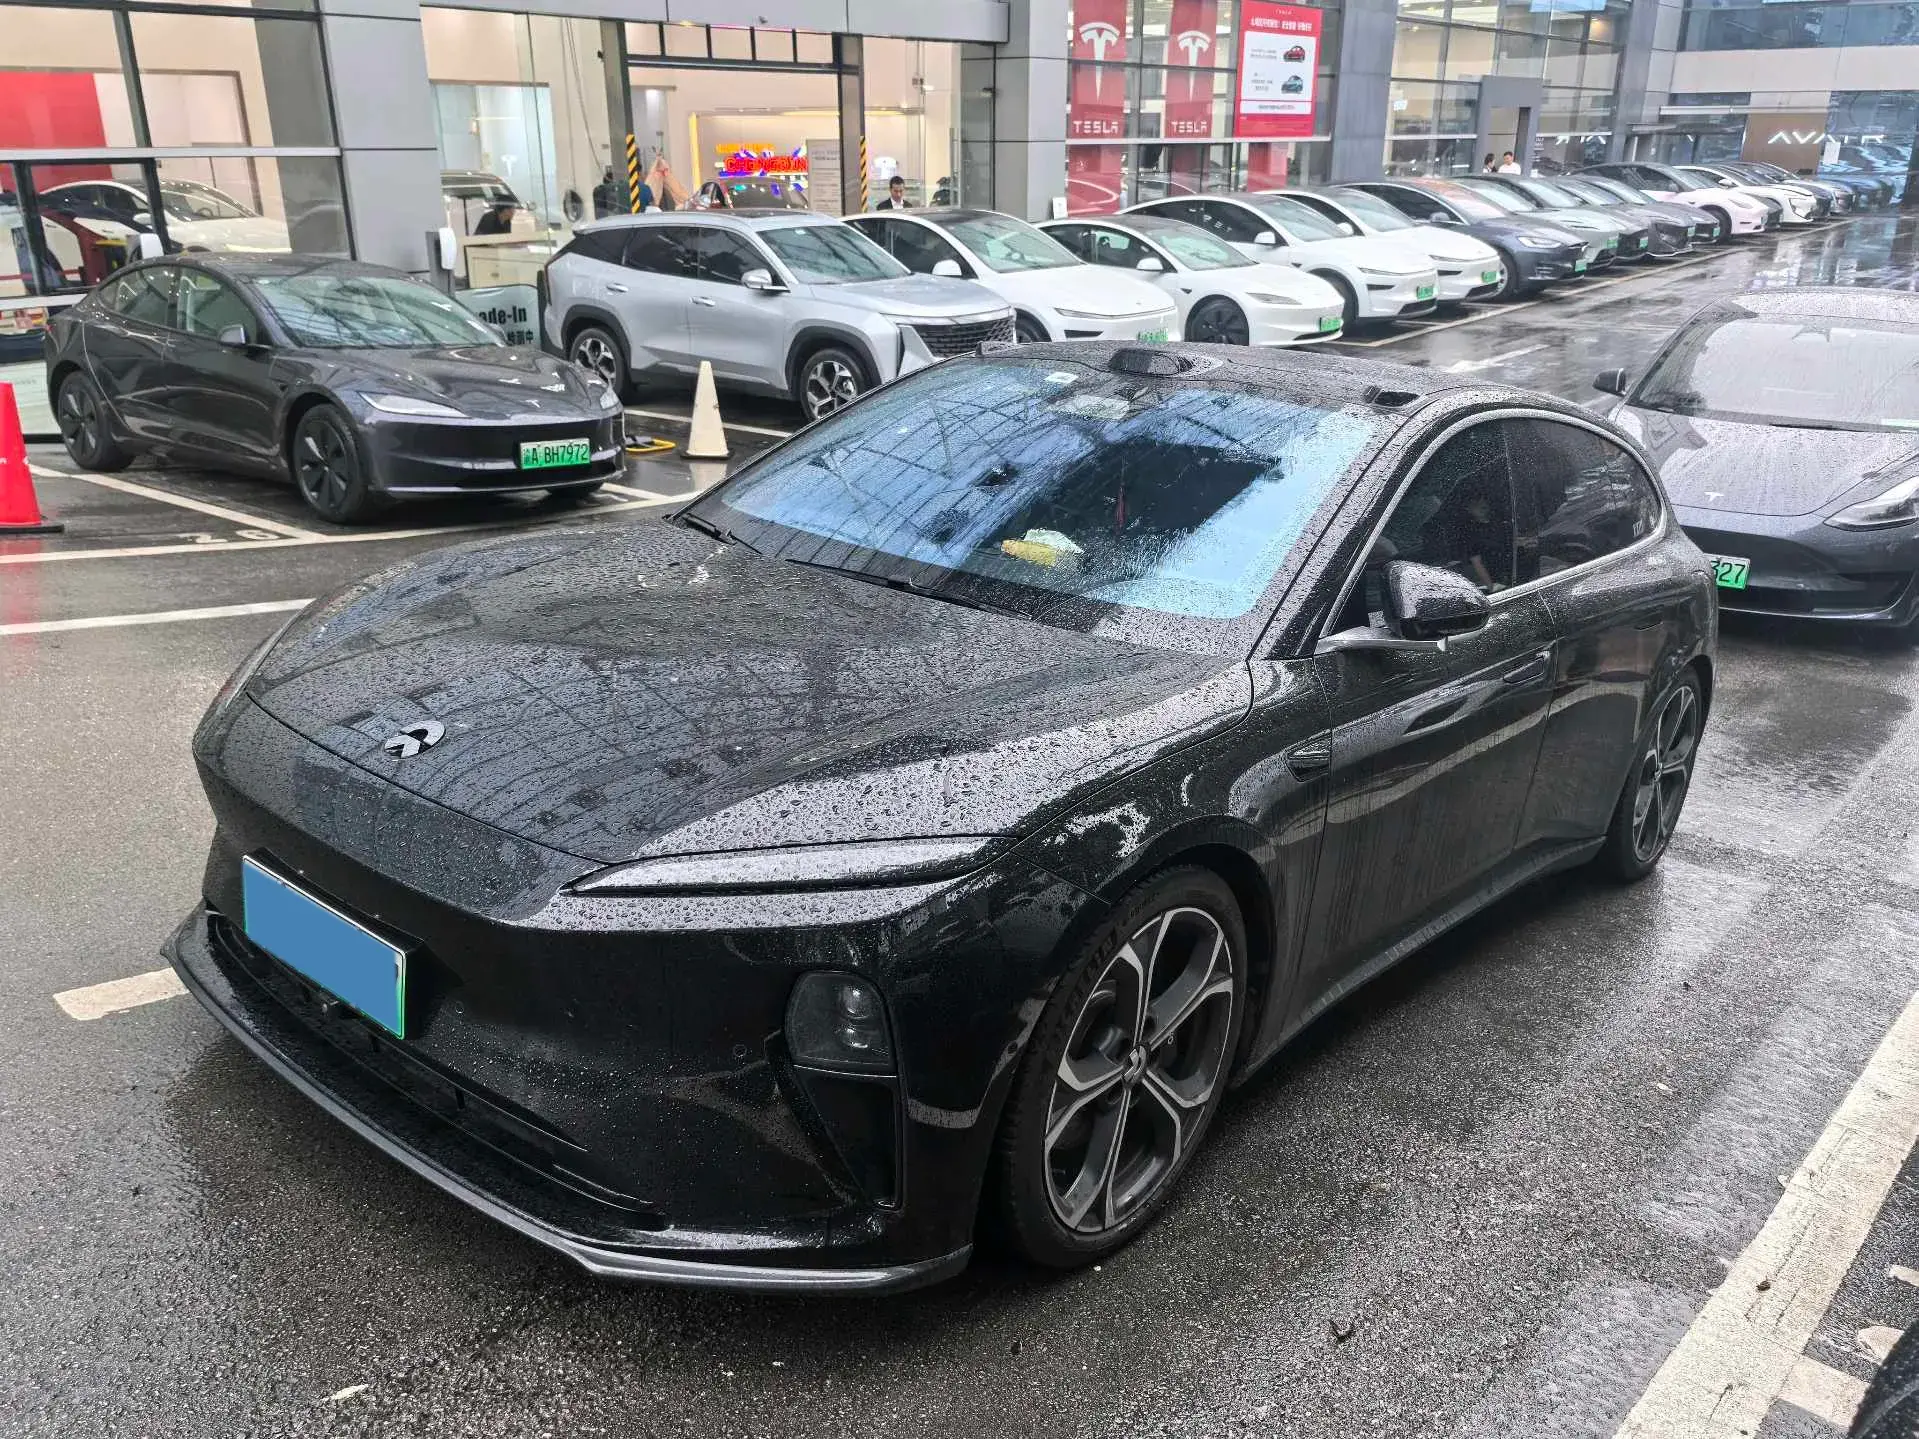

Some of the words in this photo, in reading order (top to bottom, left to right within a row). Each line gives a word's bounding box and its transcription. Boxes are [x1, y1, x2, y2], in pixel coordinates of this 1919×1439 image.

[1073, 120, 1119, 134] TESLA
[1171, 121, 1208, 133] TESLA
[475, 306, 527, 324] ade-In
[544, 443, 589, 464] BH7972
